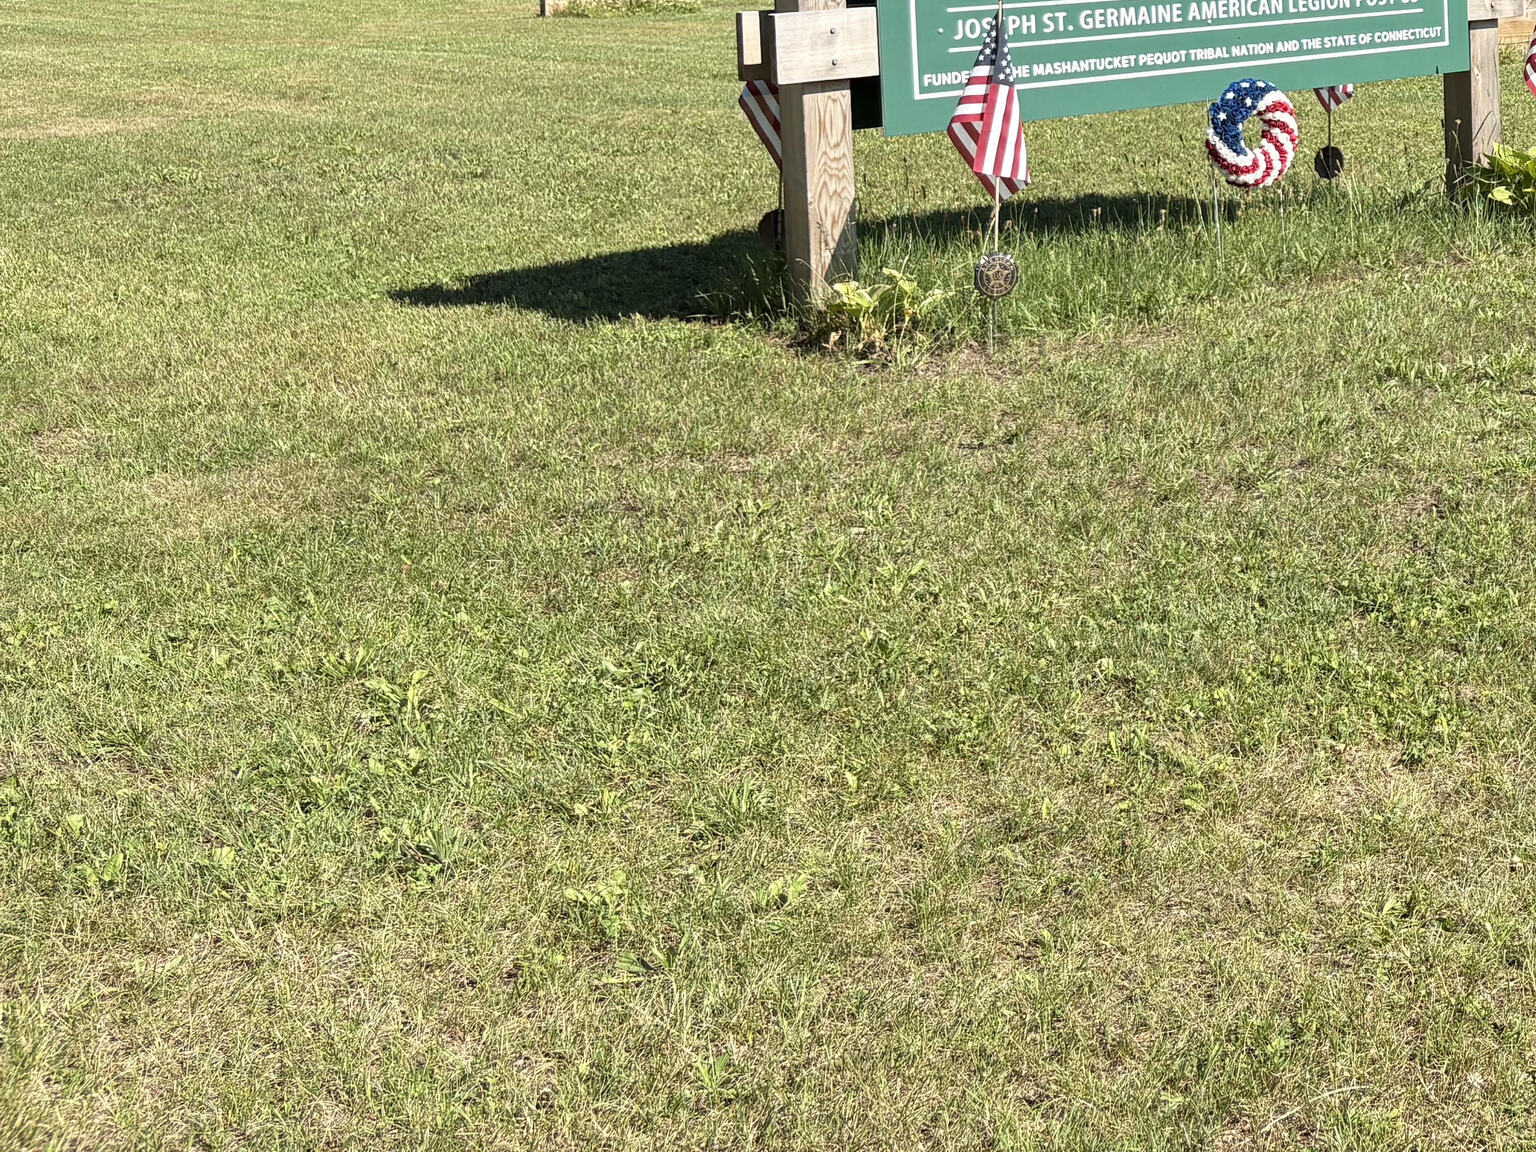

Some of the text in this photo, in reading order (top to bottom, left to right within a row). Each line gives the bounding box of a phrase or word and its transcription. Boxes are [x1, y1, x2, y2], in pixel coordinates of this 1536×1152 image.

[954, 14, 1036, 41] JOSPH
[1043, 12, 1074, 33] ST.
[1080, 3, 1182, 30] GERMAINE
[923, 26, 1442, 87] FUNDE HE MASHANTUCKET PEQUOT TRIBAL NATION AND THE STATE OF CONNECTICUT
